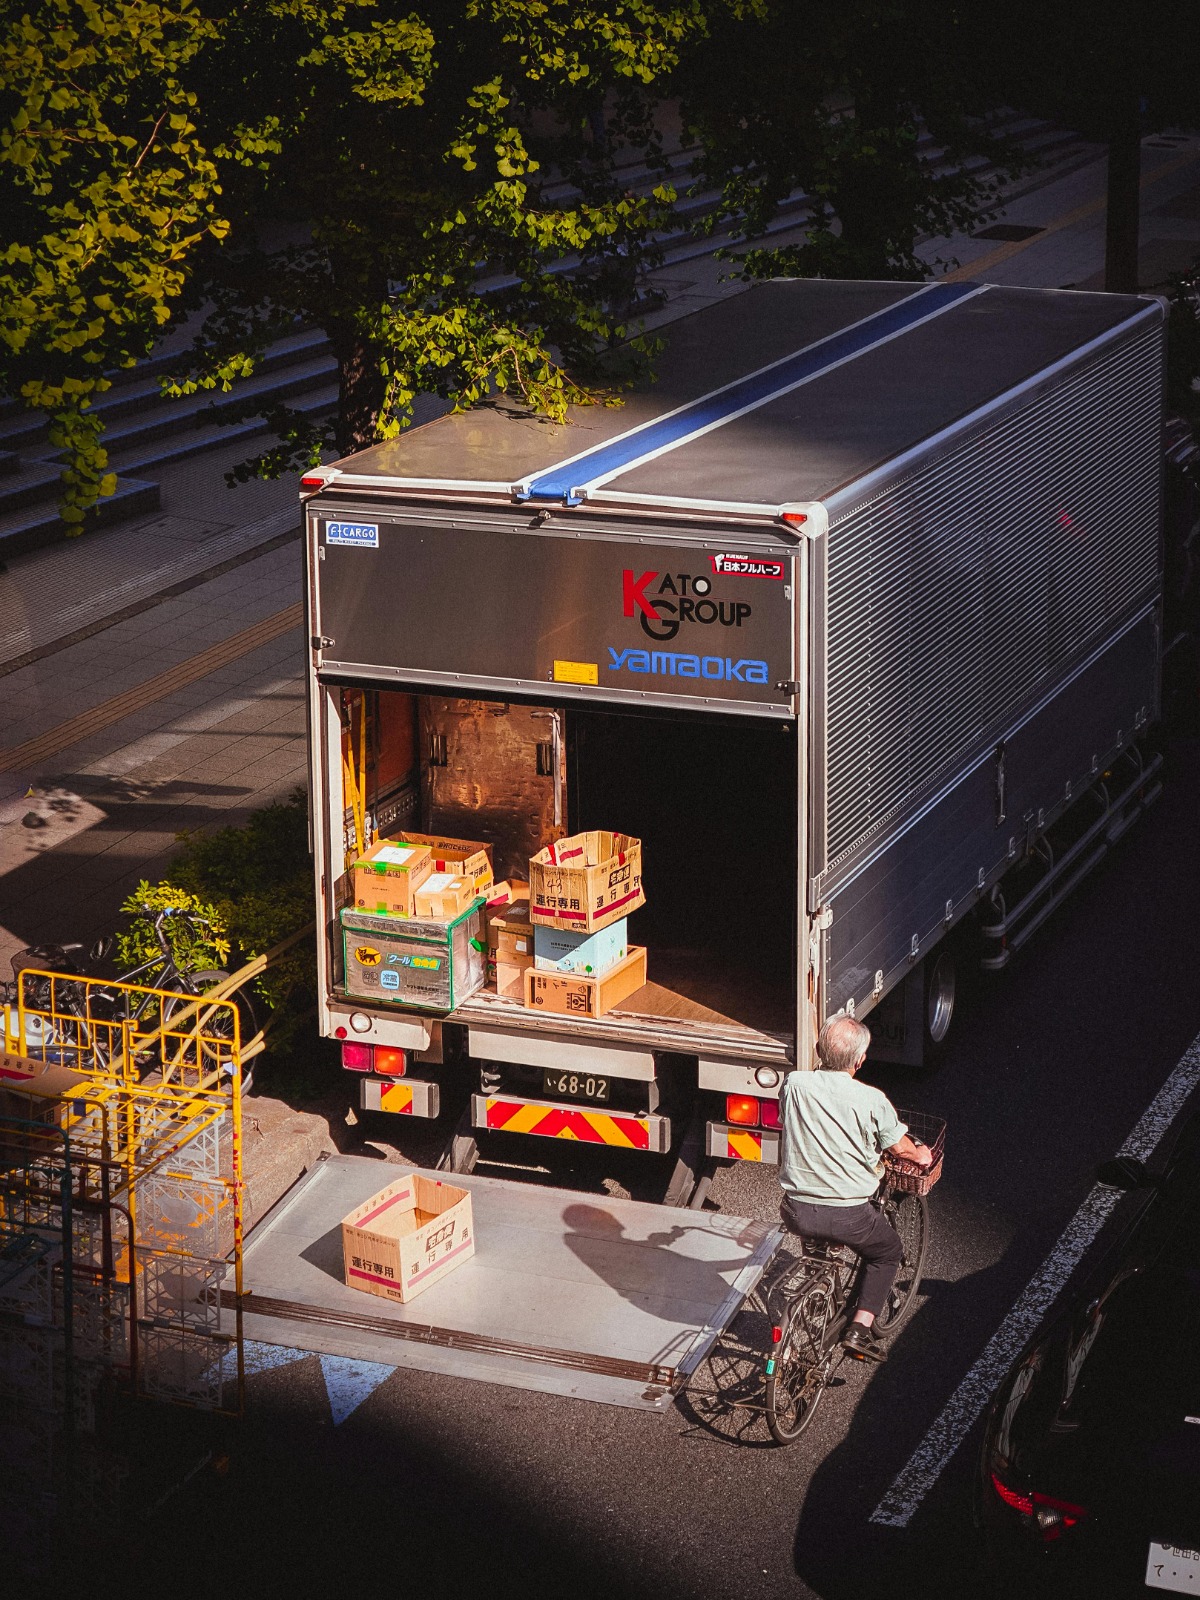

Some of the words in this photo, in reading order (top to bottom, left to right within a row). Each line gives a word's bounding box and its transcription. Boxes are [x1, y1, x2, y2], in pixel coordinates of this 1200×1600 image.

[723, 561, 781, 576] 日本フルハーフ
[622, 569, 712, 620] KATO
[640, 597, 752, 641] GROUP
[607, 646, 769, 684] yamaoka
[536, 894, 580, 910] 運行専用
[558, 1074, 606, 1098] 68-02
[351, 1255, 394, 1279] 運行専用
